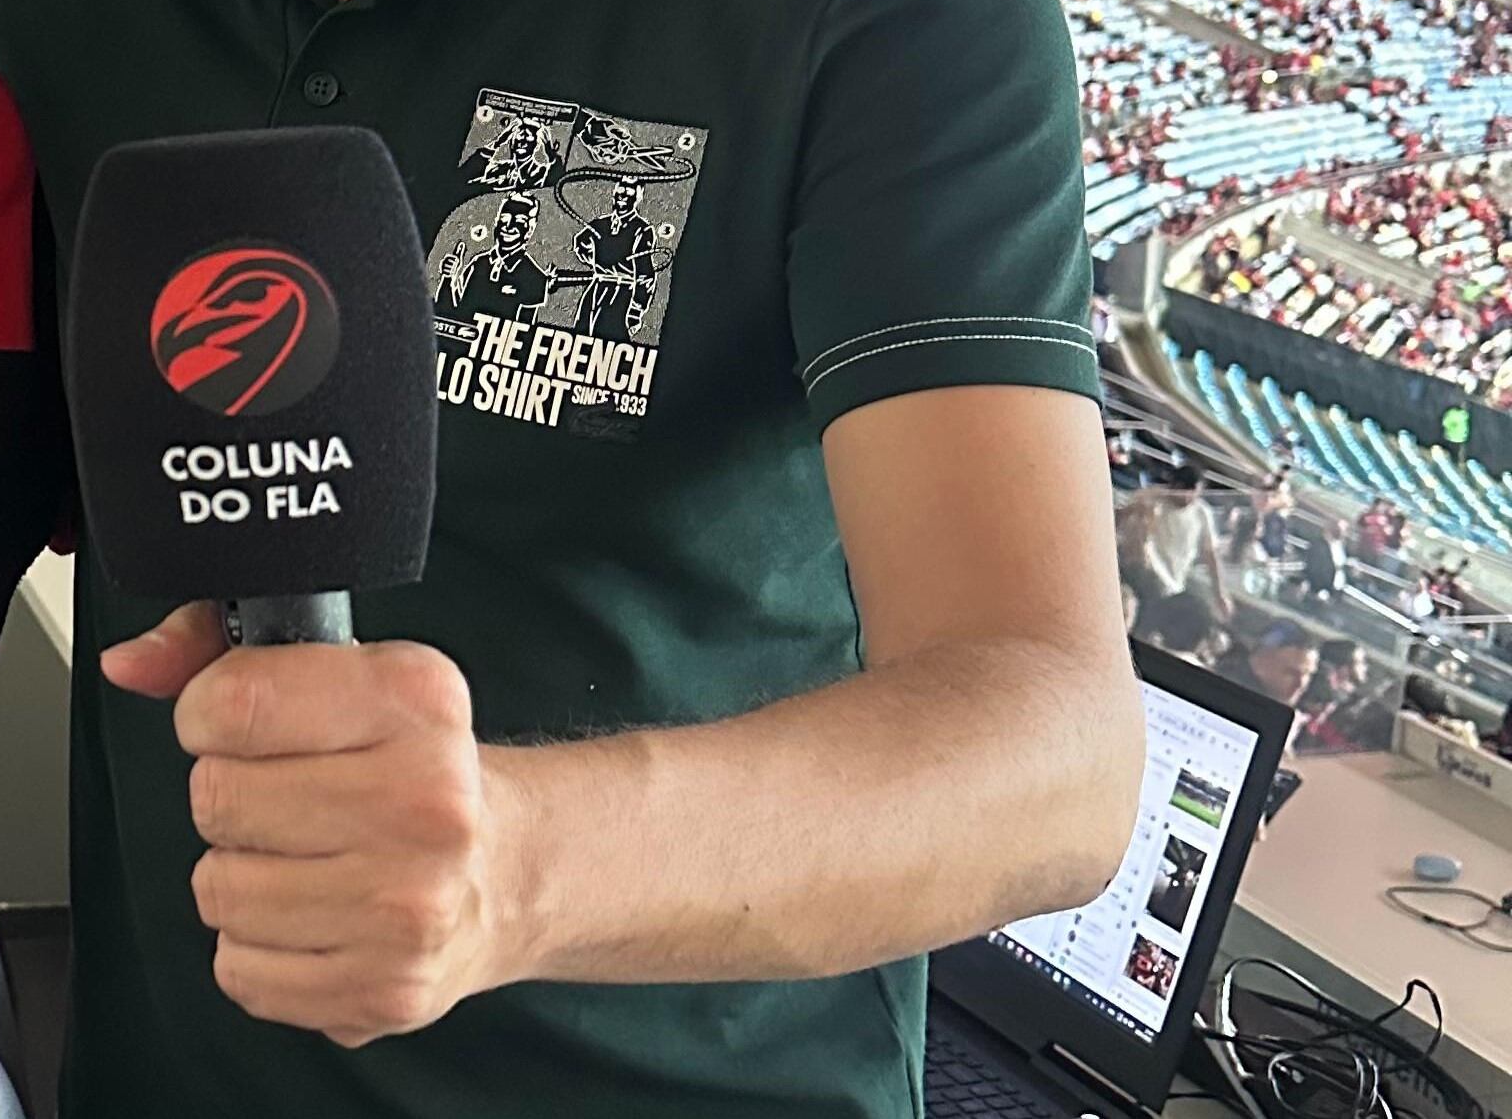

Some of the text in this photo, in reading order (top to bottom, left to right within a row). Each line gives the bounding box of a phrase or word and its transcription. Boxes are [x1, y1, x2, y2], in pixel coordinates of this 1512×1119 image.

[468, 312, 659, 395] THE FRENCH
[473, 364, 572, 427] SHIRT
[571, 384, 648, 416] SINCE 1933
[161, 436, 353, 481] COLUNA
[179, 481, 341, 524] DO FLA
